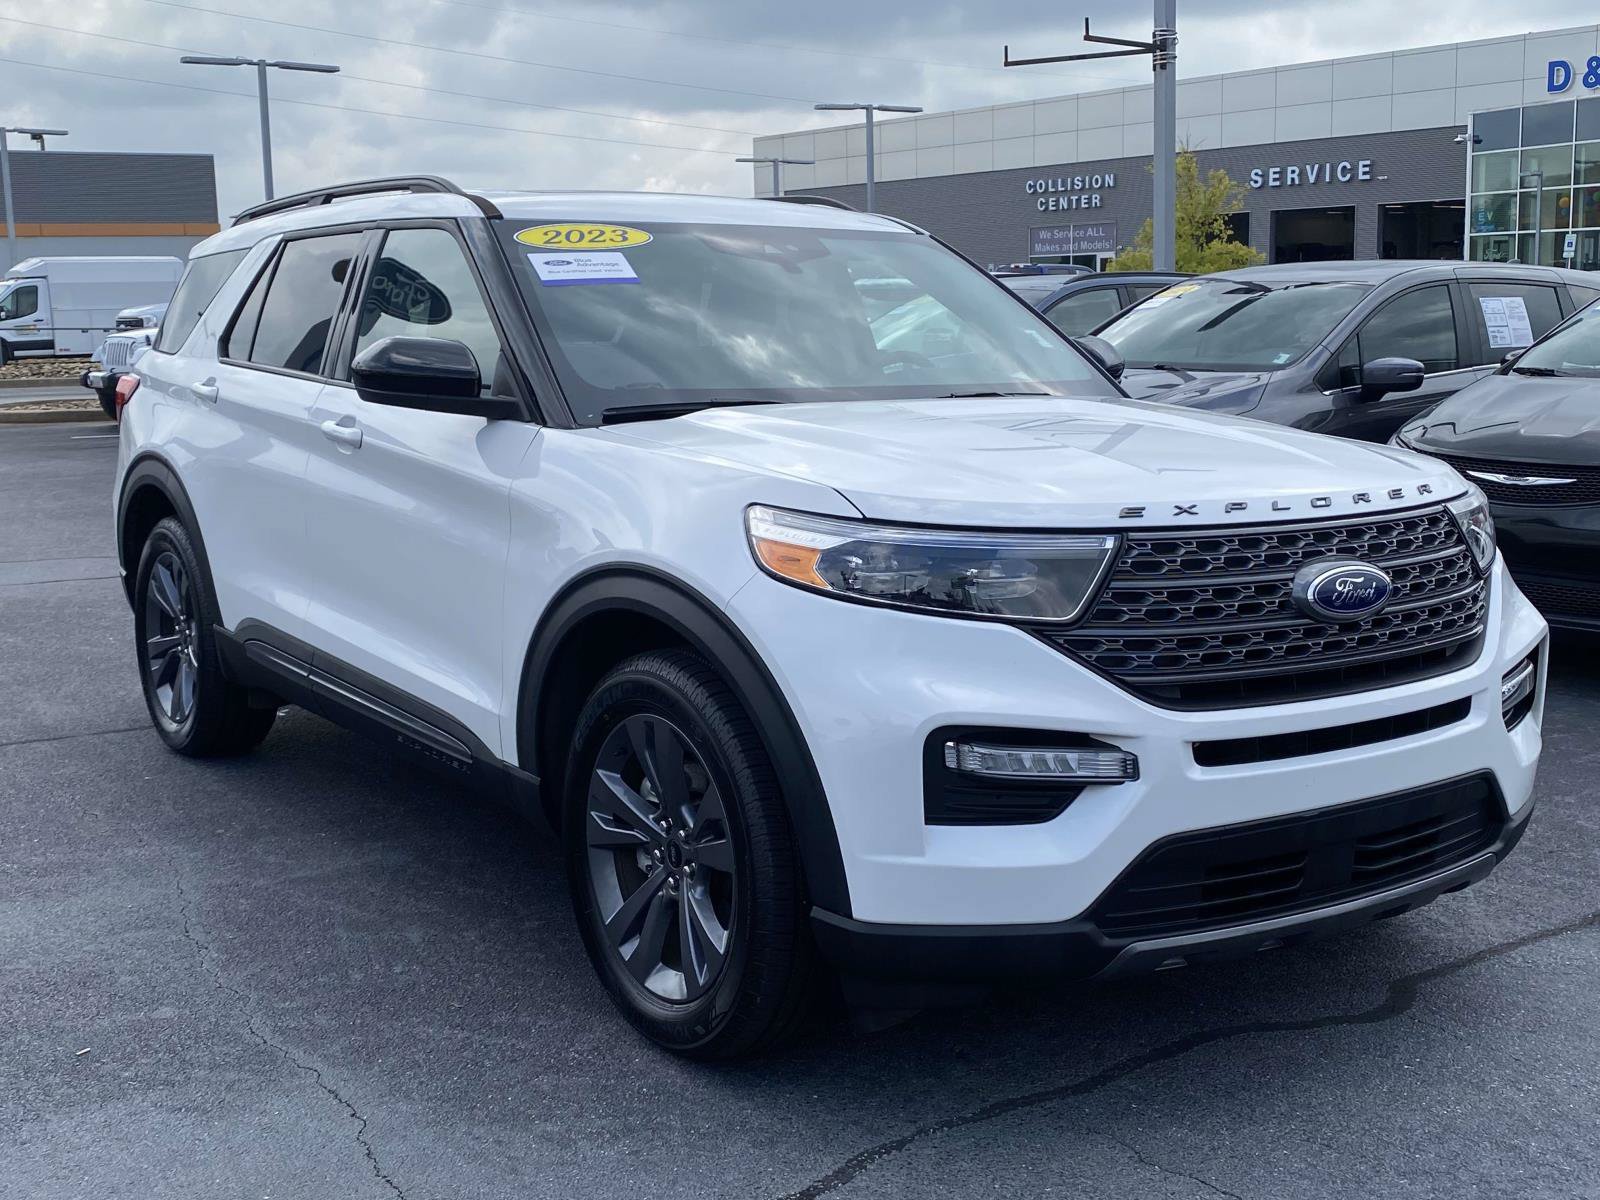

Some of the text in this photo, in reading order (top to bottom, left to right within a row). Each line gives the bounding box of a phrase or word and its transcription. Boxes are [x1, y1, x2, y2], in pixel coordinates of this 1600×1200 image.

[1547, 55, 1600, 93] D &
[1025, 173, 1114, 194] COLLISION
[1249, 159, 1371, 188] SERVICE
[1037, 194, 1101, 211] CENTER
[543, 229, 629, 245] 2023
[1039, 227, 1105, 239] We Servce ALL
[1034, 243, 1060, 252] Makes
[1118, 483, 1433, 519] EXPLORER
[1332, 576, 1377, 610] Ford
